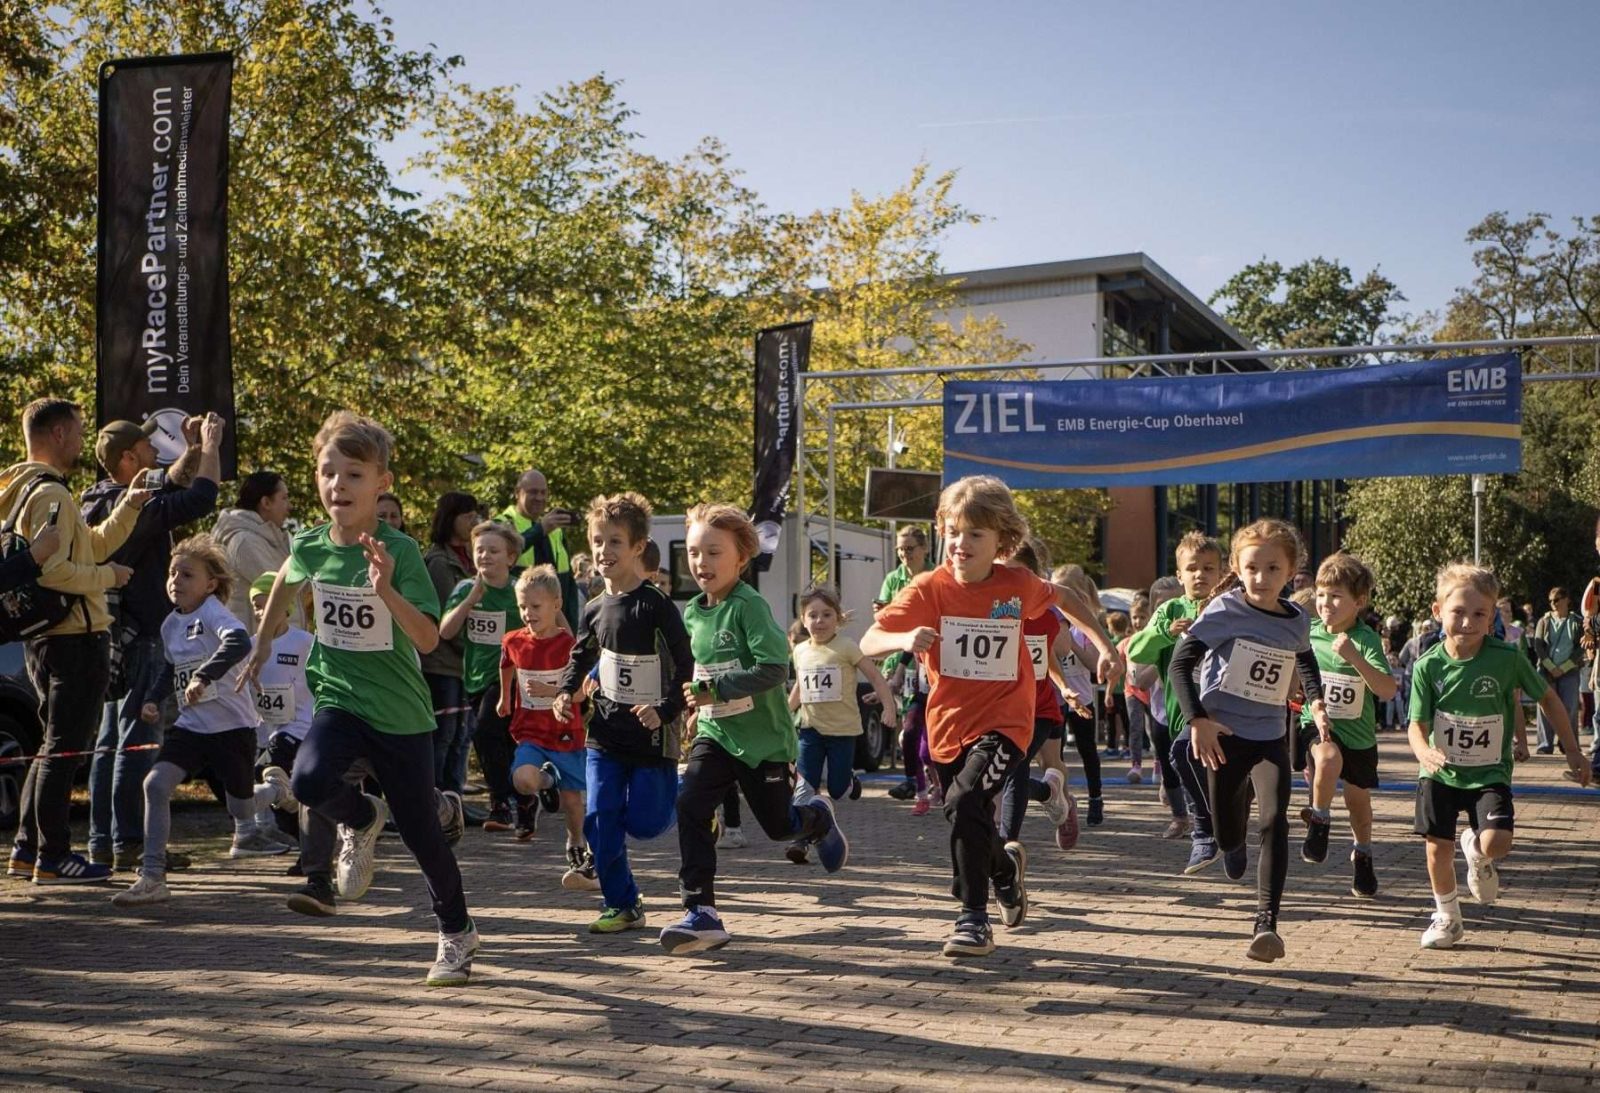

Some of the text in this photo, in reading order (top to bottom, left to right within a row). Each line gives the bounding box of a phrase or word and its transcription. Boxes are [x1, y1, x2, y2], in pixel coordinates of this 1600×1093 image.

[141, 87, 174, 393] myRacePartner.com
[174, 86, 193, 393] Dein Veranstaltungs- und Zeitnahmedienstleister
[1447, 367, 1507, 392] EMB
[954, 392, 1046, 434] ZIEL
[1057, 412, 1244, 433] EMB Energie-Cup Oberhavel
[322, 600, 375, 630] 266
[468, 617, 497, 633] 359
[955, 634, 1008, 659] 107
[619, 668, 632, 686] 5
[803, 674, 832, 689] 114
[1250, 660, 1282, 685] 65
[257, 692, 285, 710] 284
[1444, 727, 1490, 749] 154
